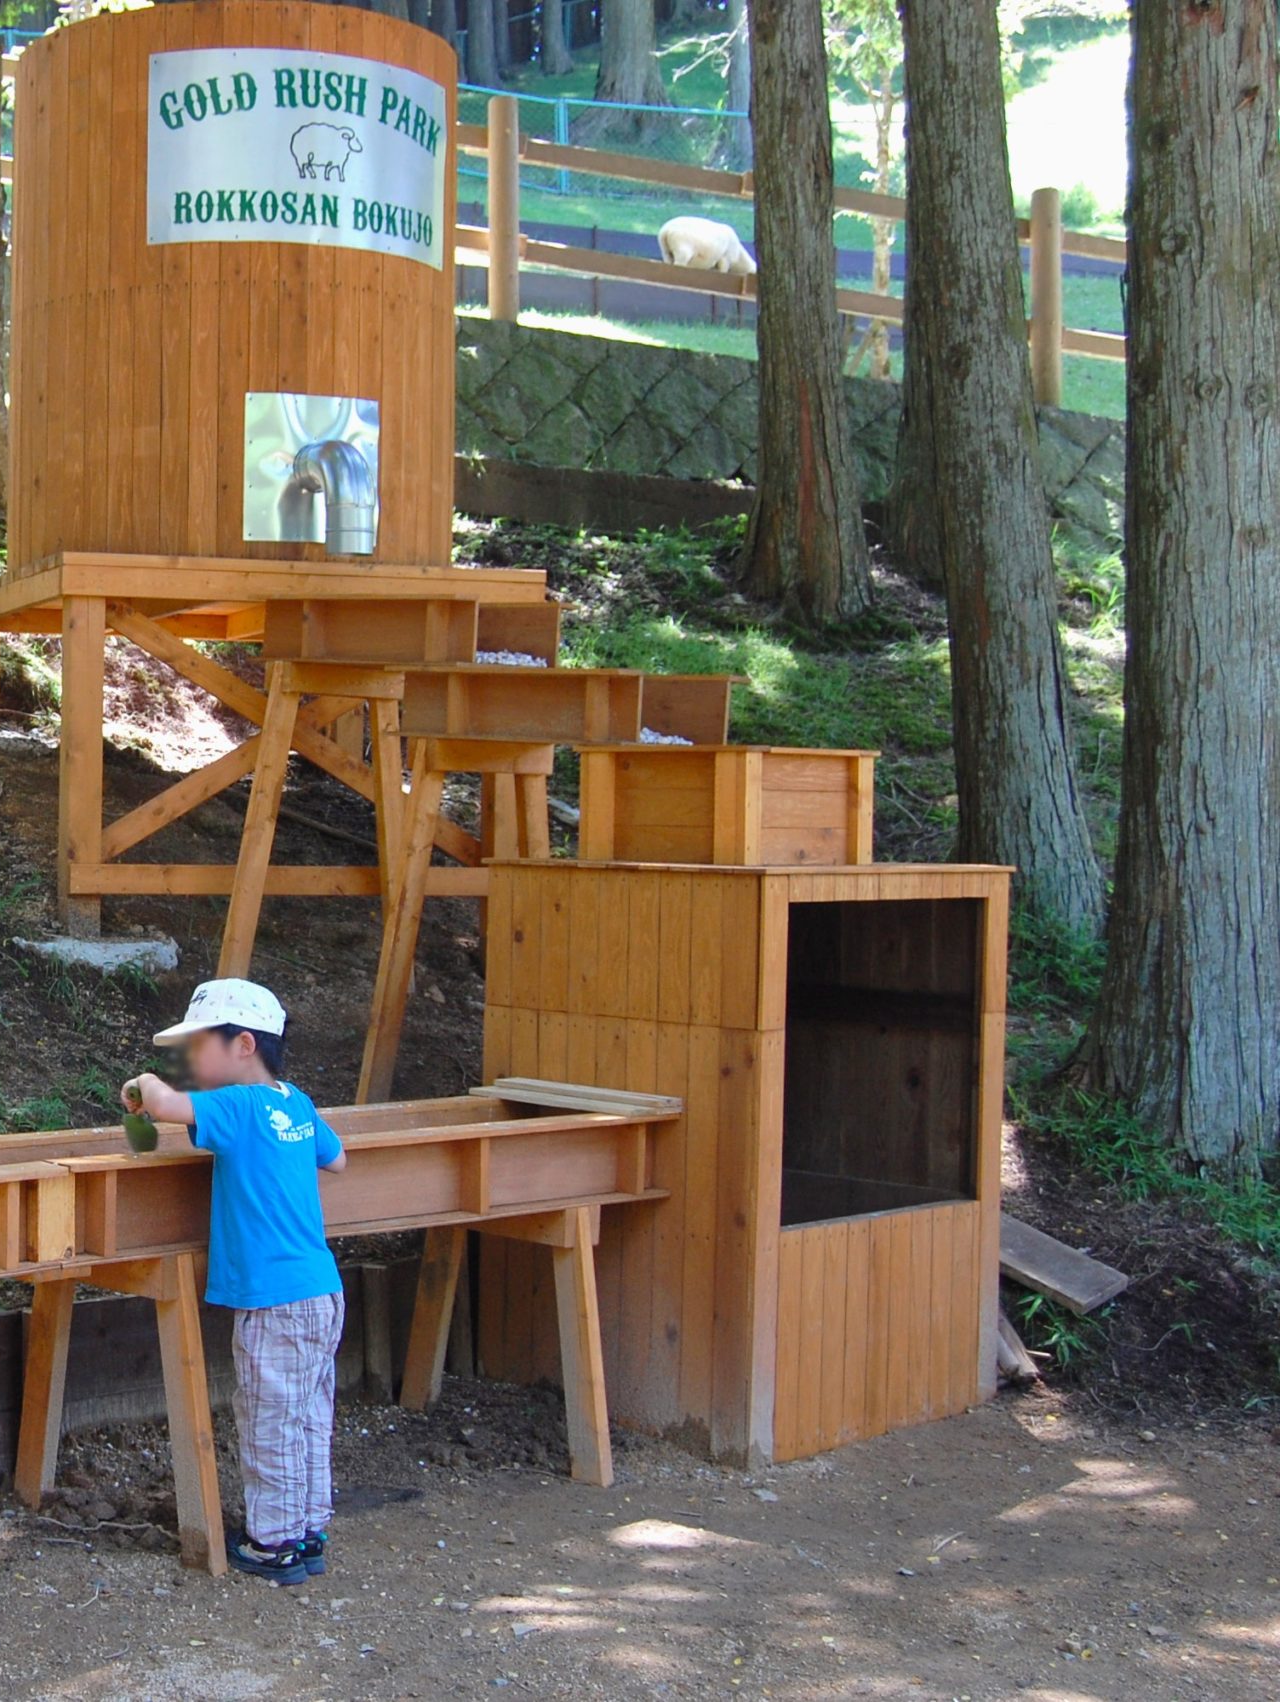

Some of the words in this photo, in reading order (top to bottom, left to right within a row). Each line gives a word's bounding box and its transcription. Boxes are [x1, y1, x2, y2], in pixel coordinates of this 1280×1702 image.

[159, 72, 258, 131] GOLD
[273, 68, 368, 118] RUSH
[378, 86, 441, 157] PARK
[173, 189, 339, 228] ROKKOSAN
[353, 198, 433, 247] BOKUJO
